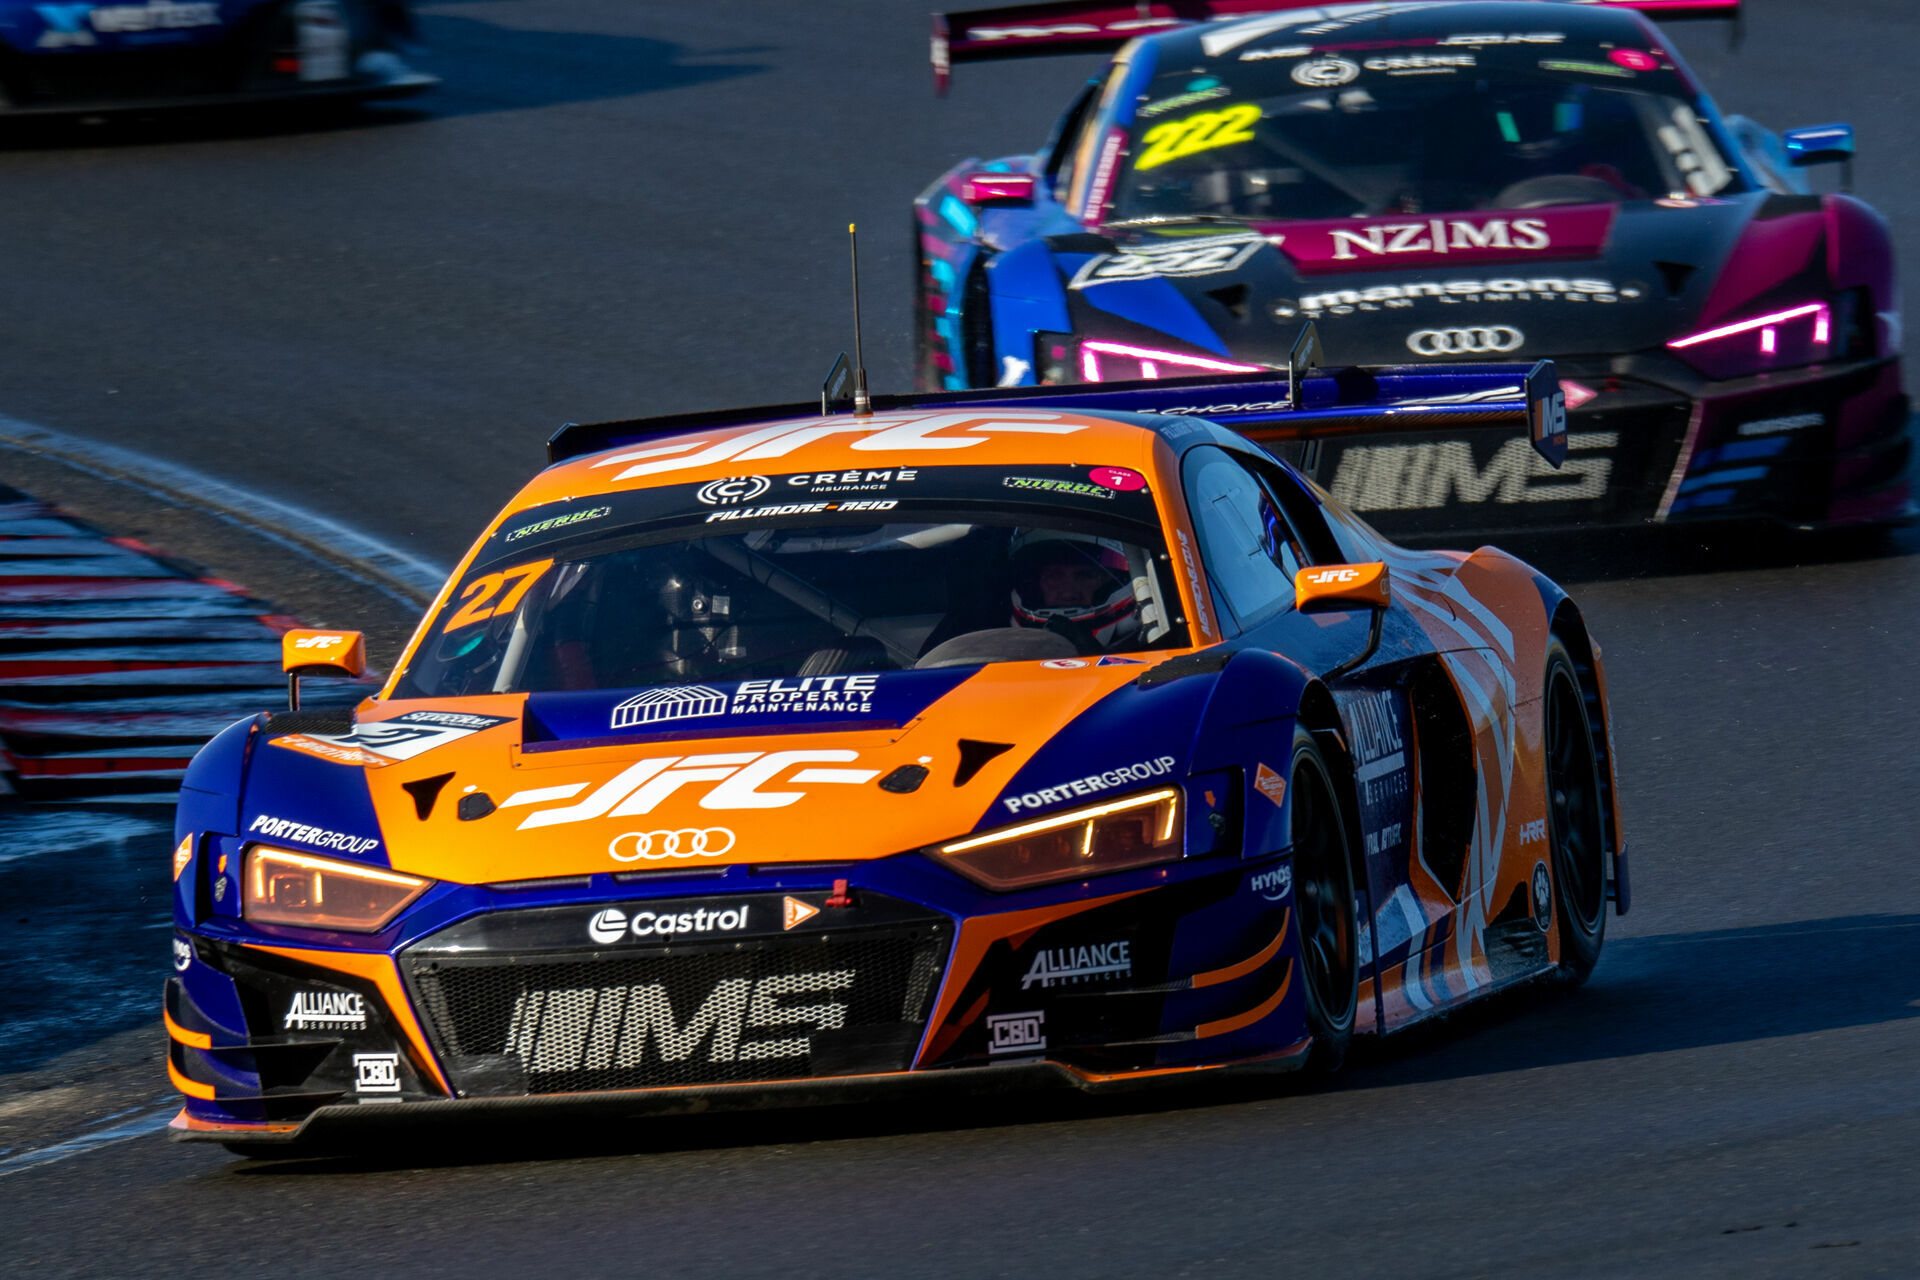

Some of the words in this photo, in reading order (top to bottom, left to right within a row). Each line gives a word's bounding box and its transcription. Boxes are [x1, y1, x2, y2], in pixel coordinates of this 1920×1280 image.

[1133, 104, 1262, 170] 222
[1095, 247, 1238, 277] 222
[1298, 277, 1617, 310] mansons
[788, 468, 919, 487] CRÈME
[1109, 469, 1131, 477] CLASS
[1111, 476, 1123, 486] 1
[810, 483, 888, 493] INSURANCE
[706, 500, 898, 523] FILLMORE-REID
[1307, 569, 1360, 583] JFC
[442, 558, 555, 634] 27
[733, 690, 874, 704] PROPERTY
[736, 674, 880, 694] ELITE
[731, 702, 872, 715] MAINTENANCE
[501, 749, 882, 830] JFC
[1003, 756, 1176, 814] PORTERGROUP
[250, 815, 379, 853] PORTERGROUP
[1519, 818, 1546, 846] HRR
[1251, 864, 1292, 892] HYNDS
[631, 905, 749, 936] Castrol
[1021, 940, 1131, 990] ALLIANCE
[1050, 969, 1132, 986] SERVICES
[284, 992, 366, 1029] ALLIANCE
[303, 1021, 367, 1030] SERVICES
[993, 1018, 1039, 1047] CBD
[360, 1063, 394, 1084] CBD
